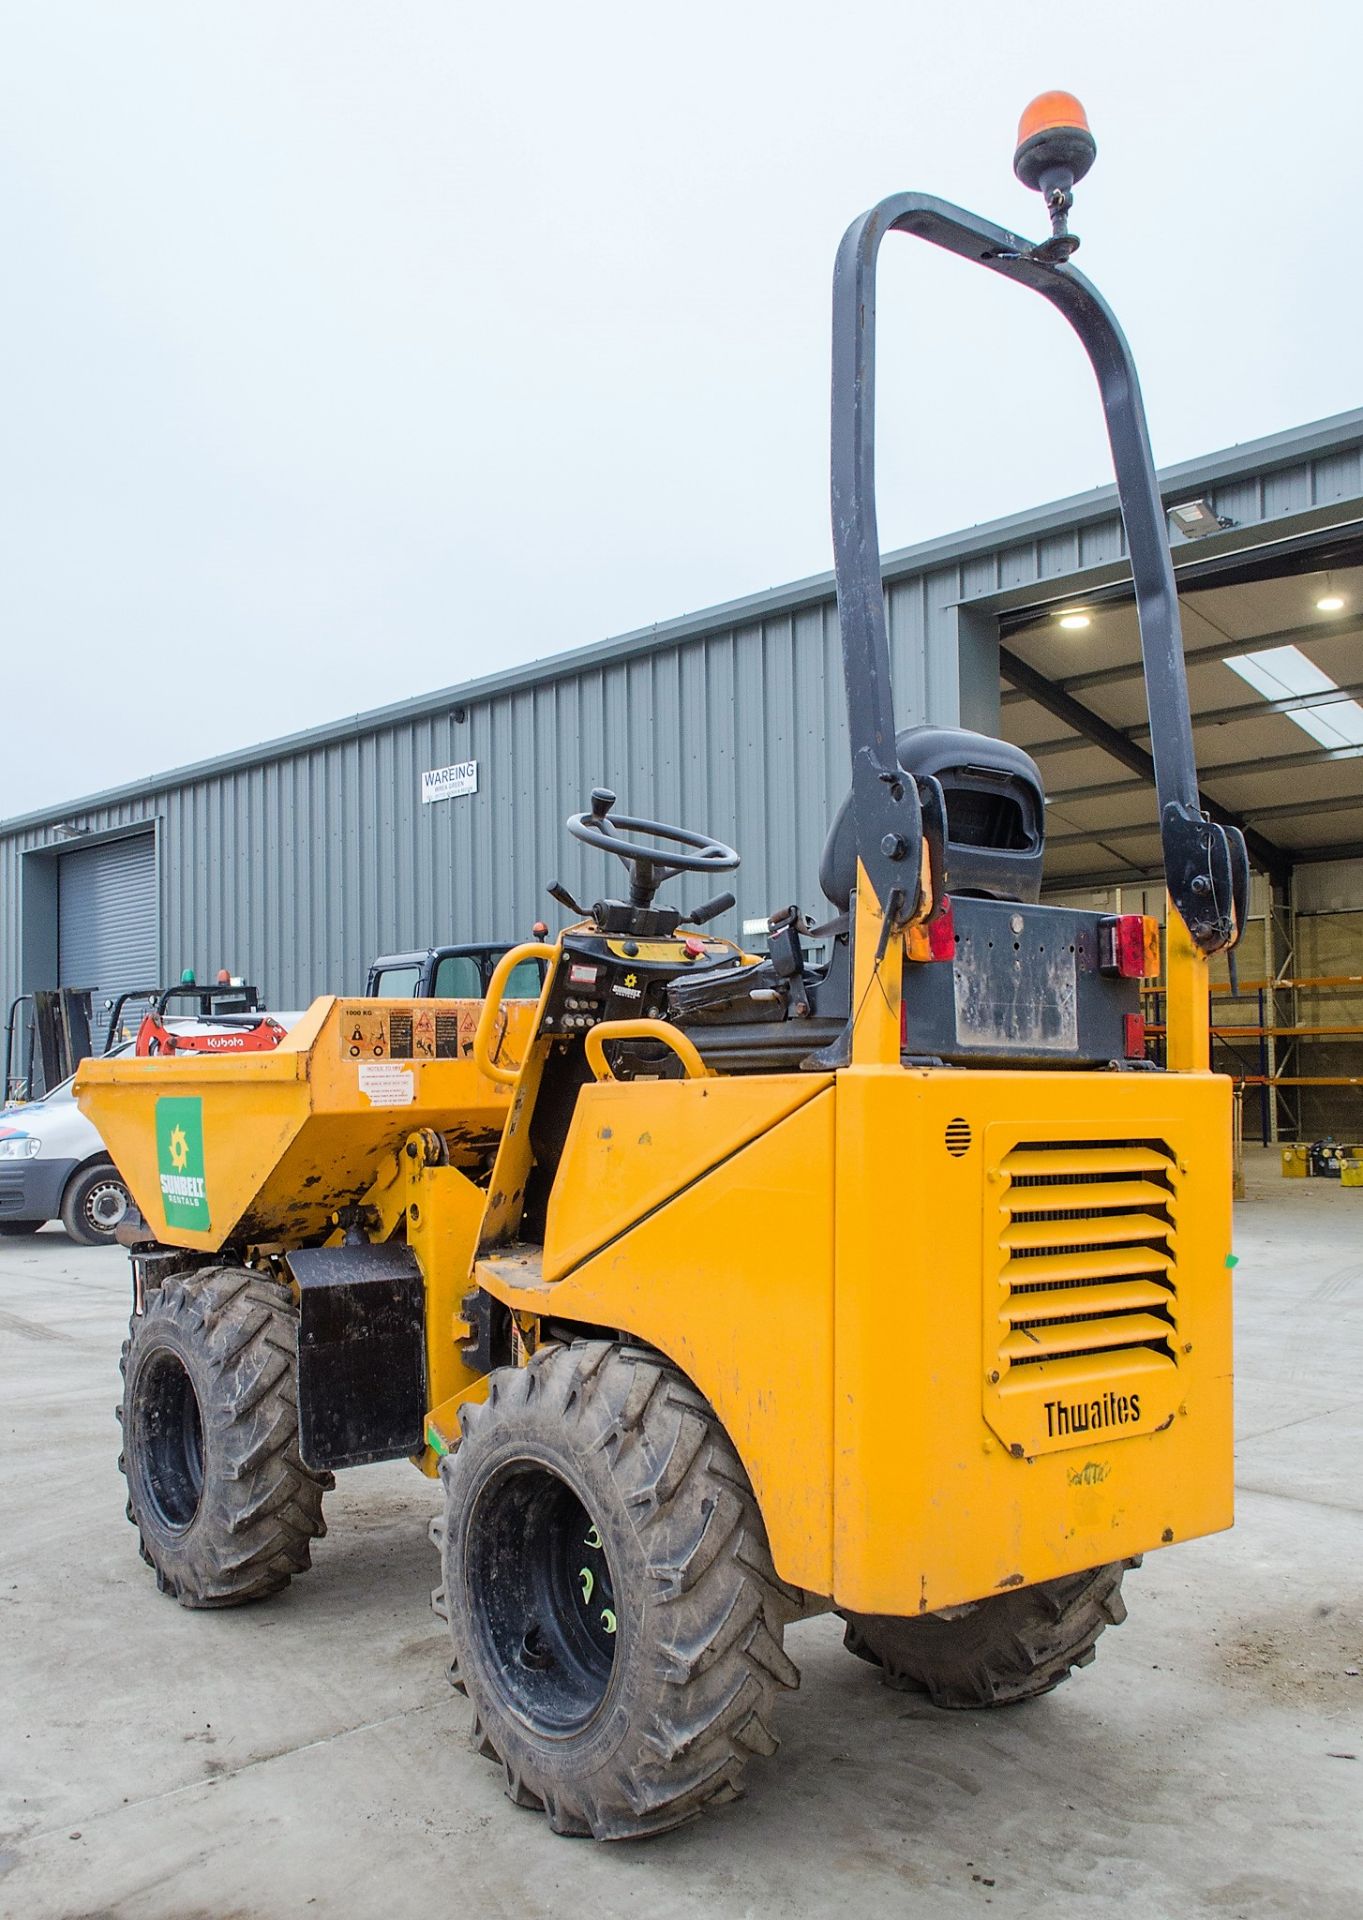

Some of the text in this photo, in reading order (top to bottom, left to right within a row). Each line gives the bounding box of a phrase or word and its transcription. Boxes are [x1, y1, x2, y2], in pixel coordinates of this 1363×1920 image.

[425, 763, 474, 786] WAREING
[207, 1037, 244, 1048] Kubota
[160, 1174, 204, 1198] SUNBELT
[168, 1194, 200, 1207] RENTALS
[1044, 1392, 1140, 1437] Thwaites
